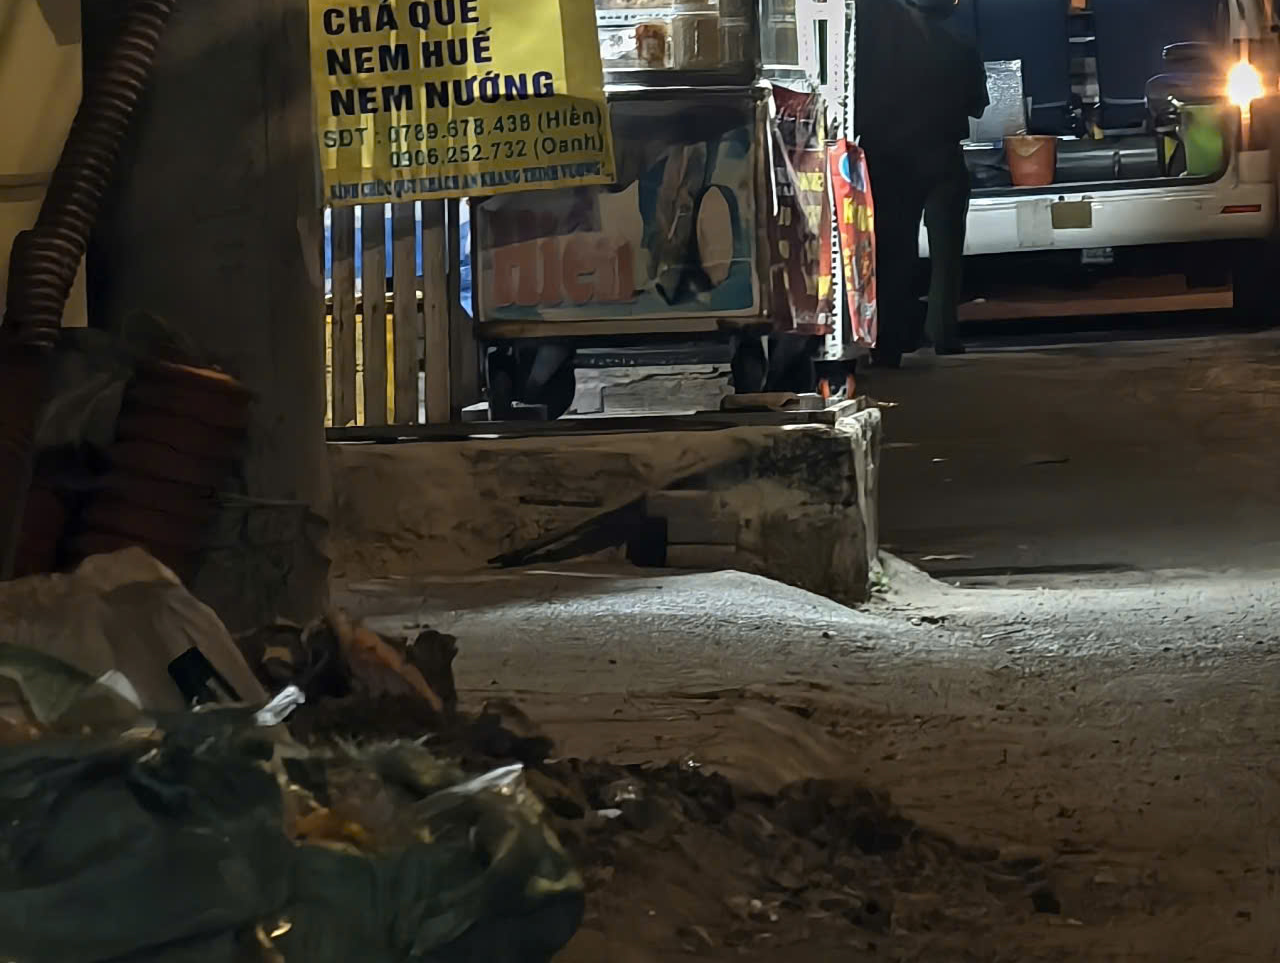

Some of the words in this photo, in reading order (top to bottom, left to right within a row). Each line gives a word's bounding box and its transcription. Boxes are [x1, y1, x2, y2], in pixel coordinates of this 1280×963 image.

[327, 43, 410, 76] NEM
[422, 27, 492, 68] HUẾ
[330, 84, 413, 117] NEM
[425, 71, 555, 109] NƯỚNG
[533, 132, 604, 161] (Oanh)
